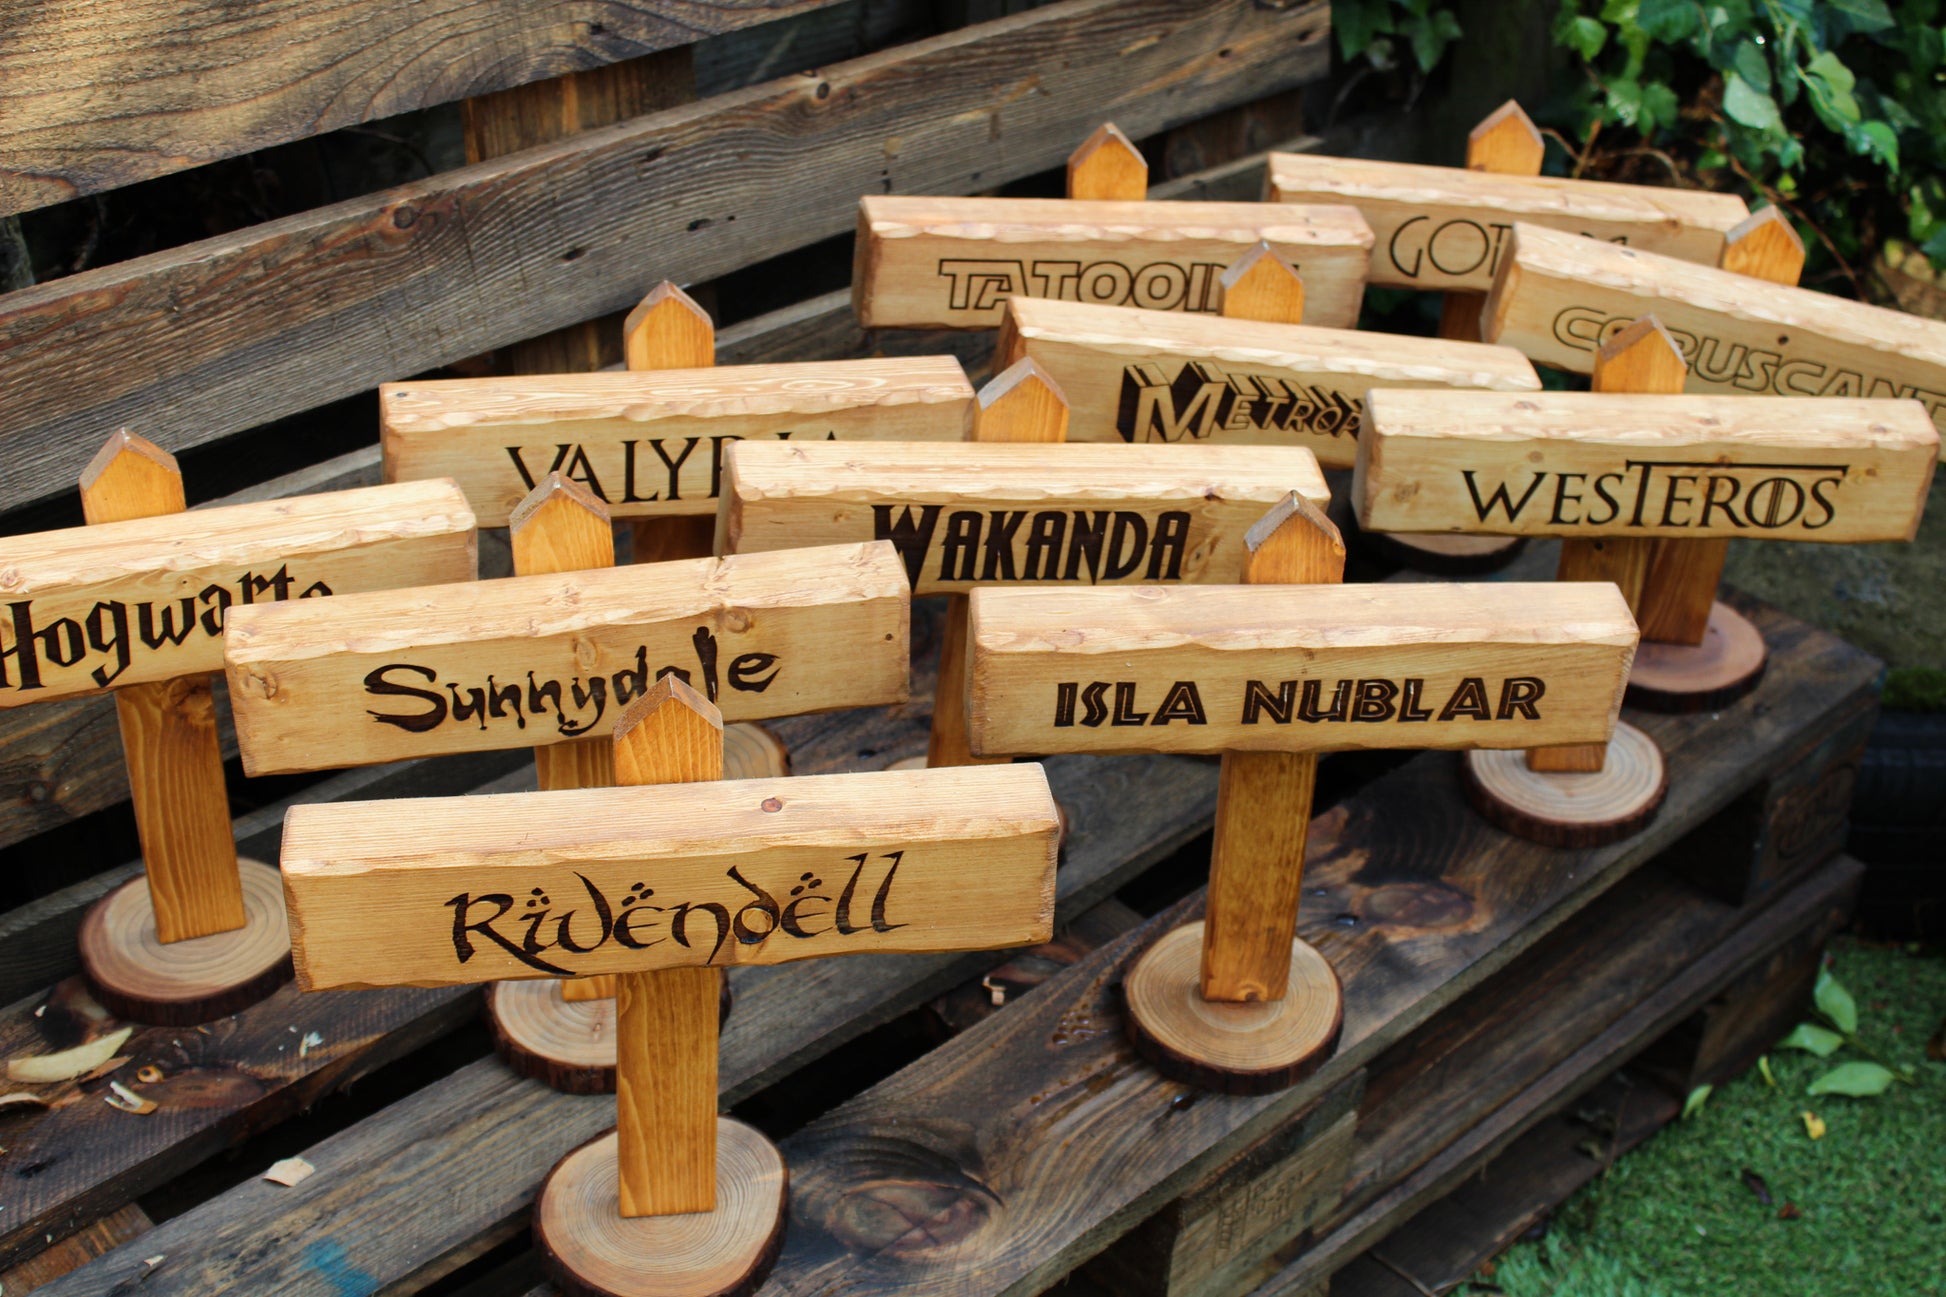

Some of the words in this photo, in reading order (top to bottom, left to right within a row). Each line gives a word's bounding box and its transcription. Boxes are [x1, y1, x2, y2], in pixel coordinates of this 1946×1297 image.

[938, 258, 1300, 312] TATOOI
[1116, 361, 1365, 443] METROP
[505, 430, 838, 504] VALY
[1462, 460, 1850, 530] WESTEROS
[871, 504, 1191, 594] WAKANDA
[1053, 680, 1208, 728] ISLA
[1240, 676, 1546, 725] NUBLAR
